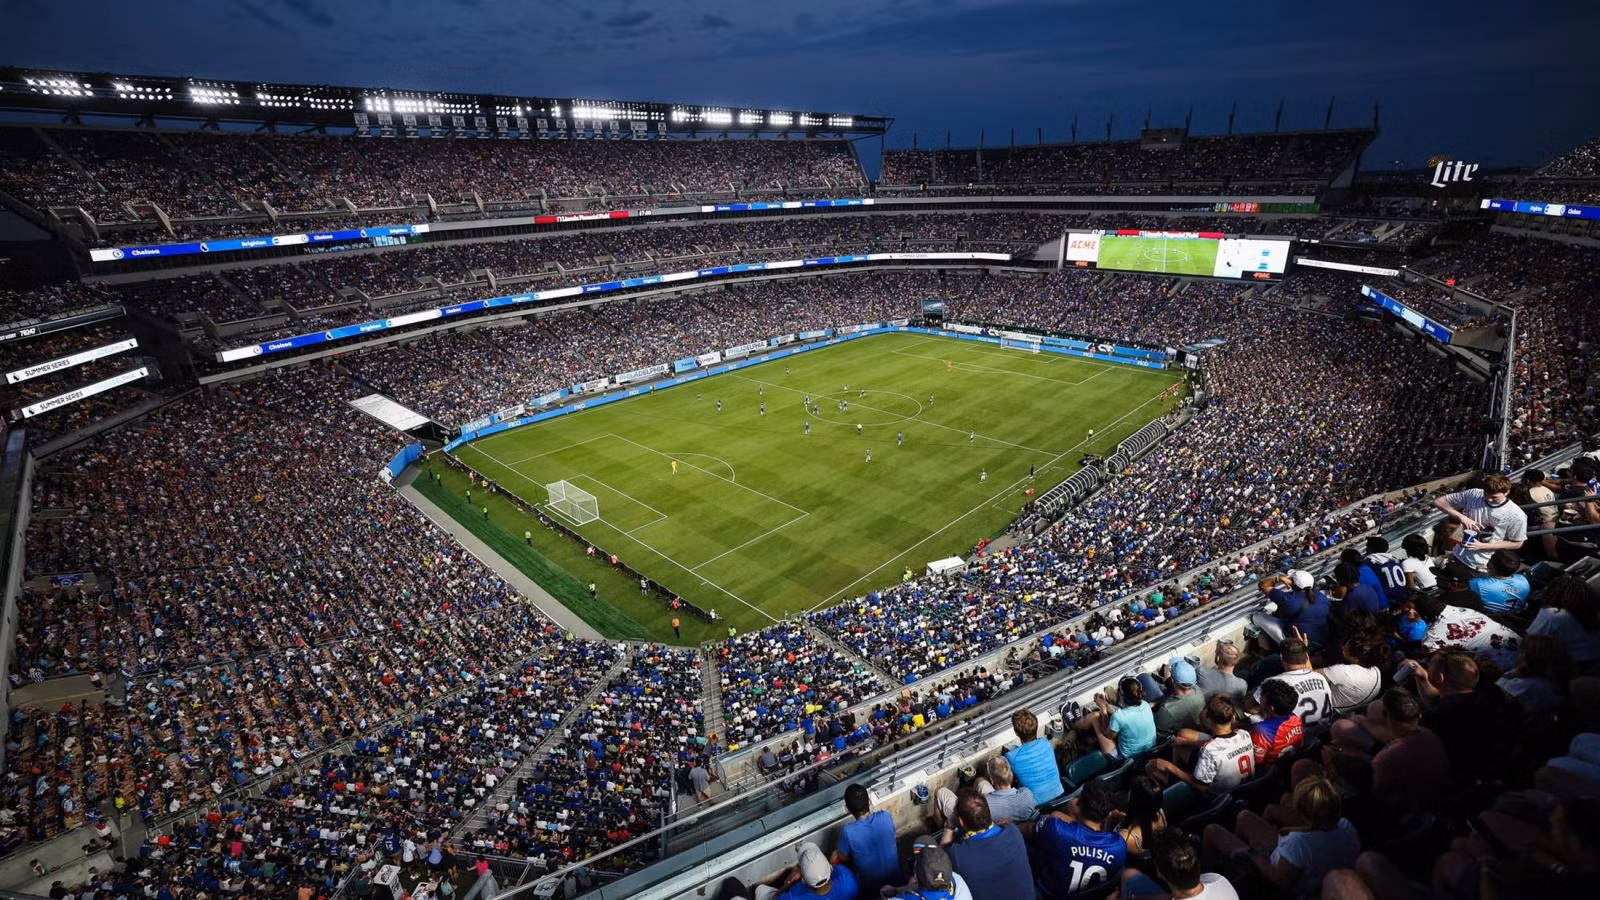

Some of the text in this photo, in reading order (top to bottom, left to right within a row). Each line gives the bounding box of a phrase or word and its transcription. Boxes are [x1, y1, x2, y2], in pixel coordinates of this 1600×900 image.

[1430, 160, 1480, 188] Lite
[131, 248, 160, 256] Chelsea
[1071, 239, 1097, 250] ACME
[268, 341, 292, 350] Chelsea
[24, 359, 70, 377] SUMMER SERIES
[618, 365, 665, 381] PHILADELPHIA
[39, 391, 83, 411] SUMMER SERIES
[1381, 565, 1407, 589] 10
[1295, 679, 1325, 694] GRIFFEY
[1298, 692, 1332, 723] 24
[1285, 726, 1302, 743] JAMES
[1238, 755, 1252, 777] 9
[1070, 846, 1115, 864] PULISIC
[1068, 860, 1108, 894] 10
